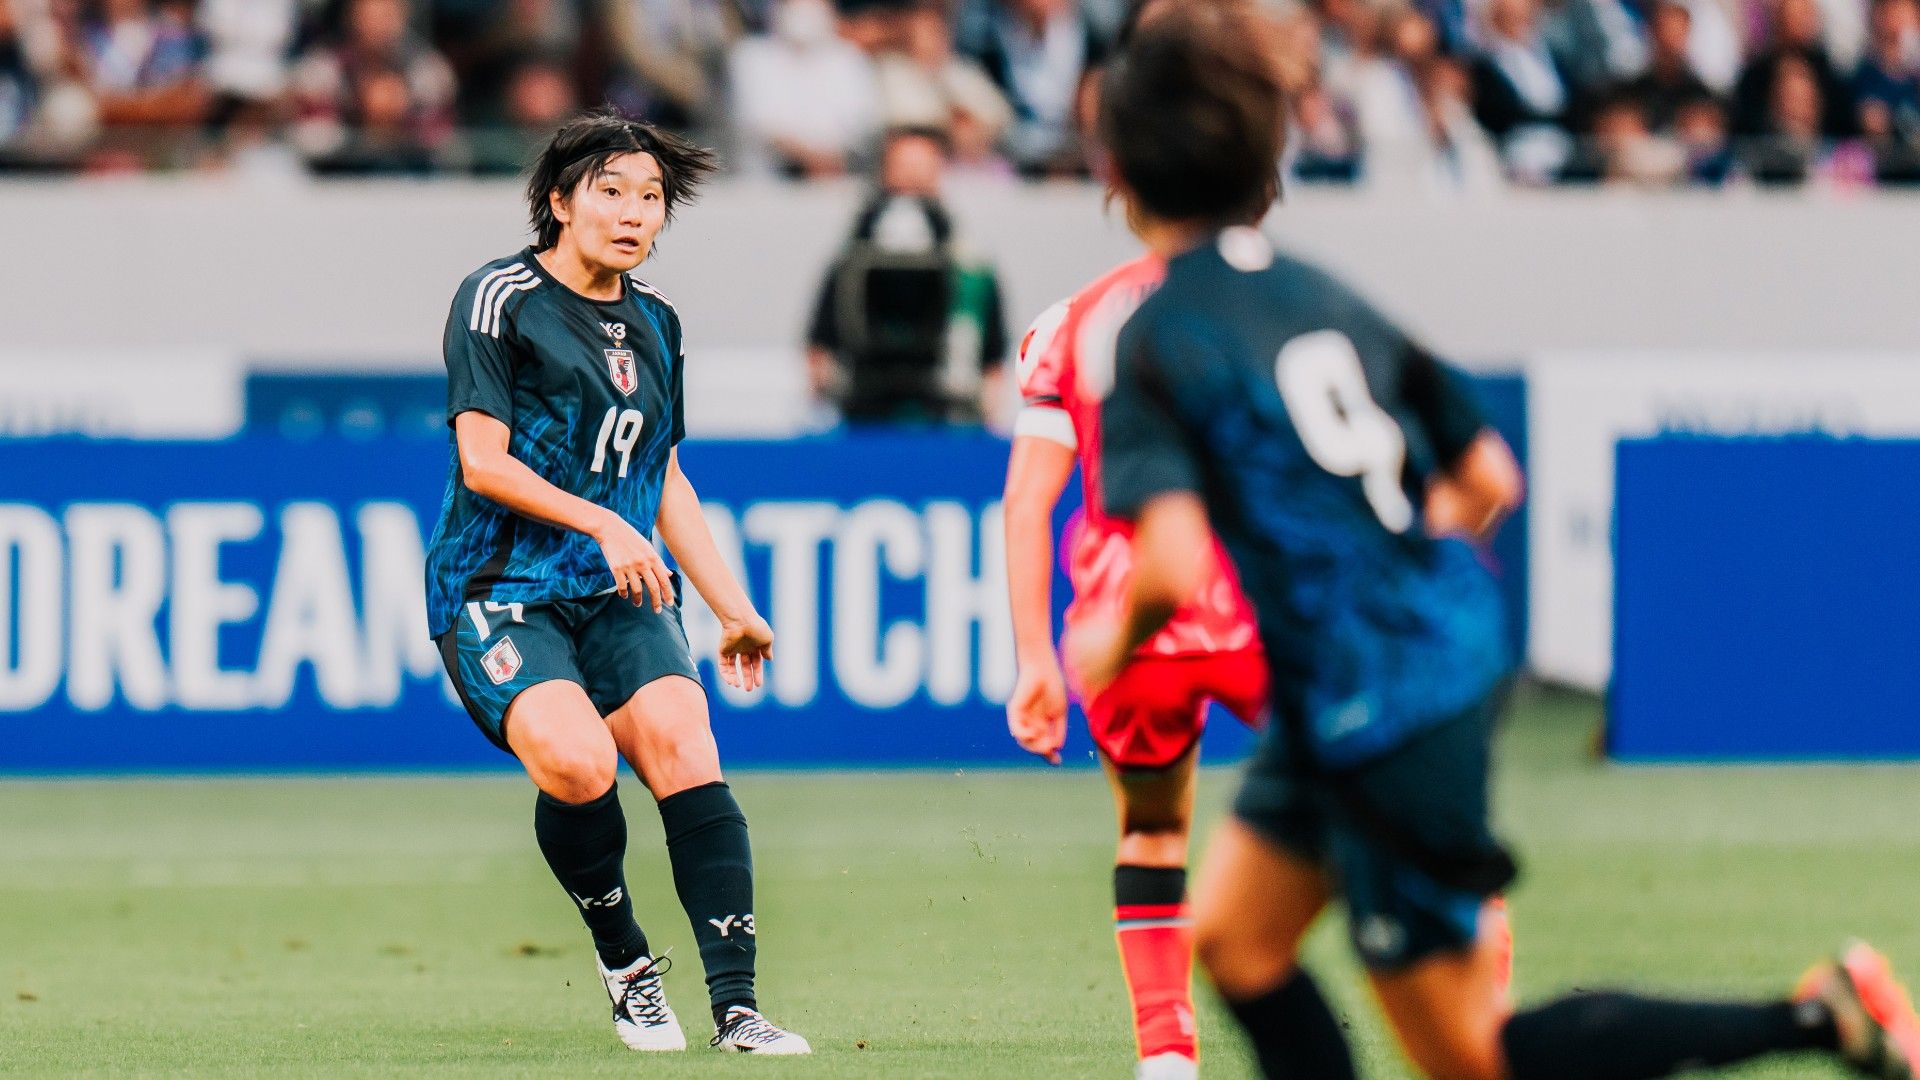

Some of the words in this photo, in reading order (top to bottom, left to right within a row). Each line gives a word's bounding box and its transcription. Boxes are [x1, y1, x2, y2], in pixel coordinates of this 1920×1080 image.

[599, 322, 626, 340] Y-3
[590, 406, 643, 478] 19
[1275, 330, 1413, 533] 9
[683, 499, 1019, 708] ATCH
[572, 886, 623, 910] Y-3
[708, 914, 755, 937] Y-3
